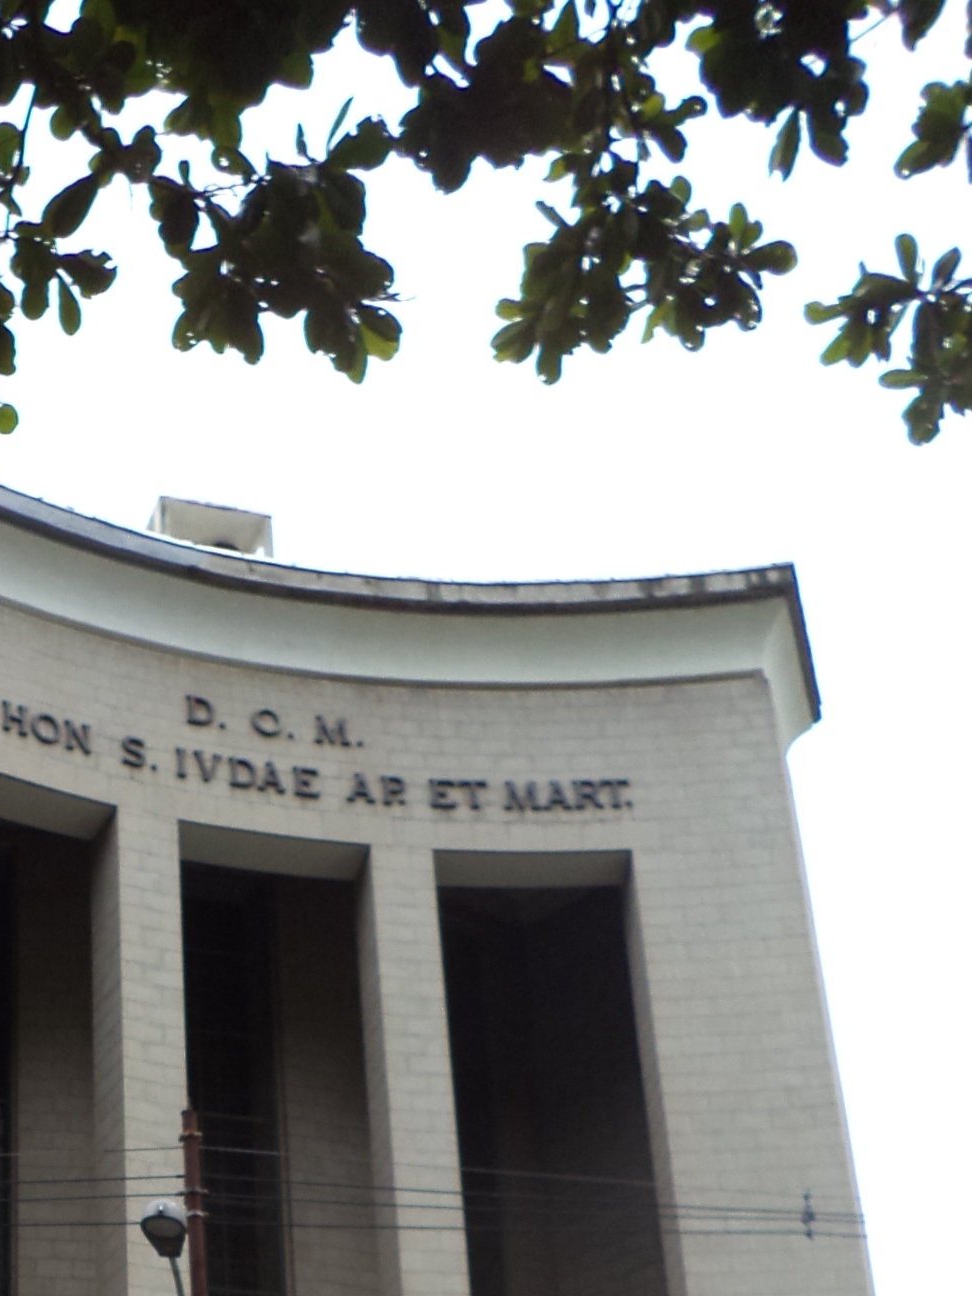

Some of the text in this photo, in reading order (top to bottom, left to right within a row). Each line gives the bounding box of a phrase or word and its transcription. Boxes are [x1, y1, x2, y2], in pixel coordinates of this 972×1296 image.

[0, 700, 92, 756] HON
[120, 736, 159, 772] S.
[175, 747, 322, 800] IVDAE
[427, 776, 488, 811] ET
[503, 777, 635, 812] MART.
[185, 693, 227, 730] D.
[314, 714, 365, 747] M.
